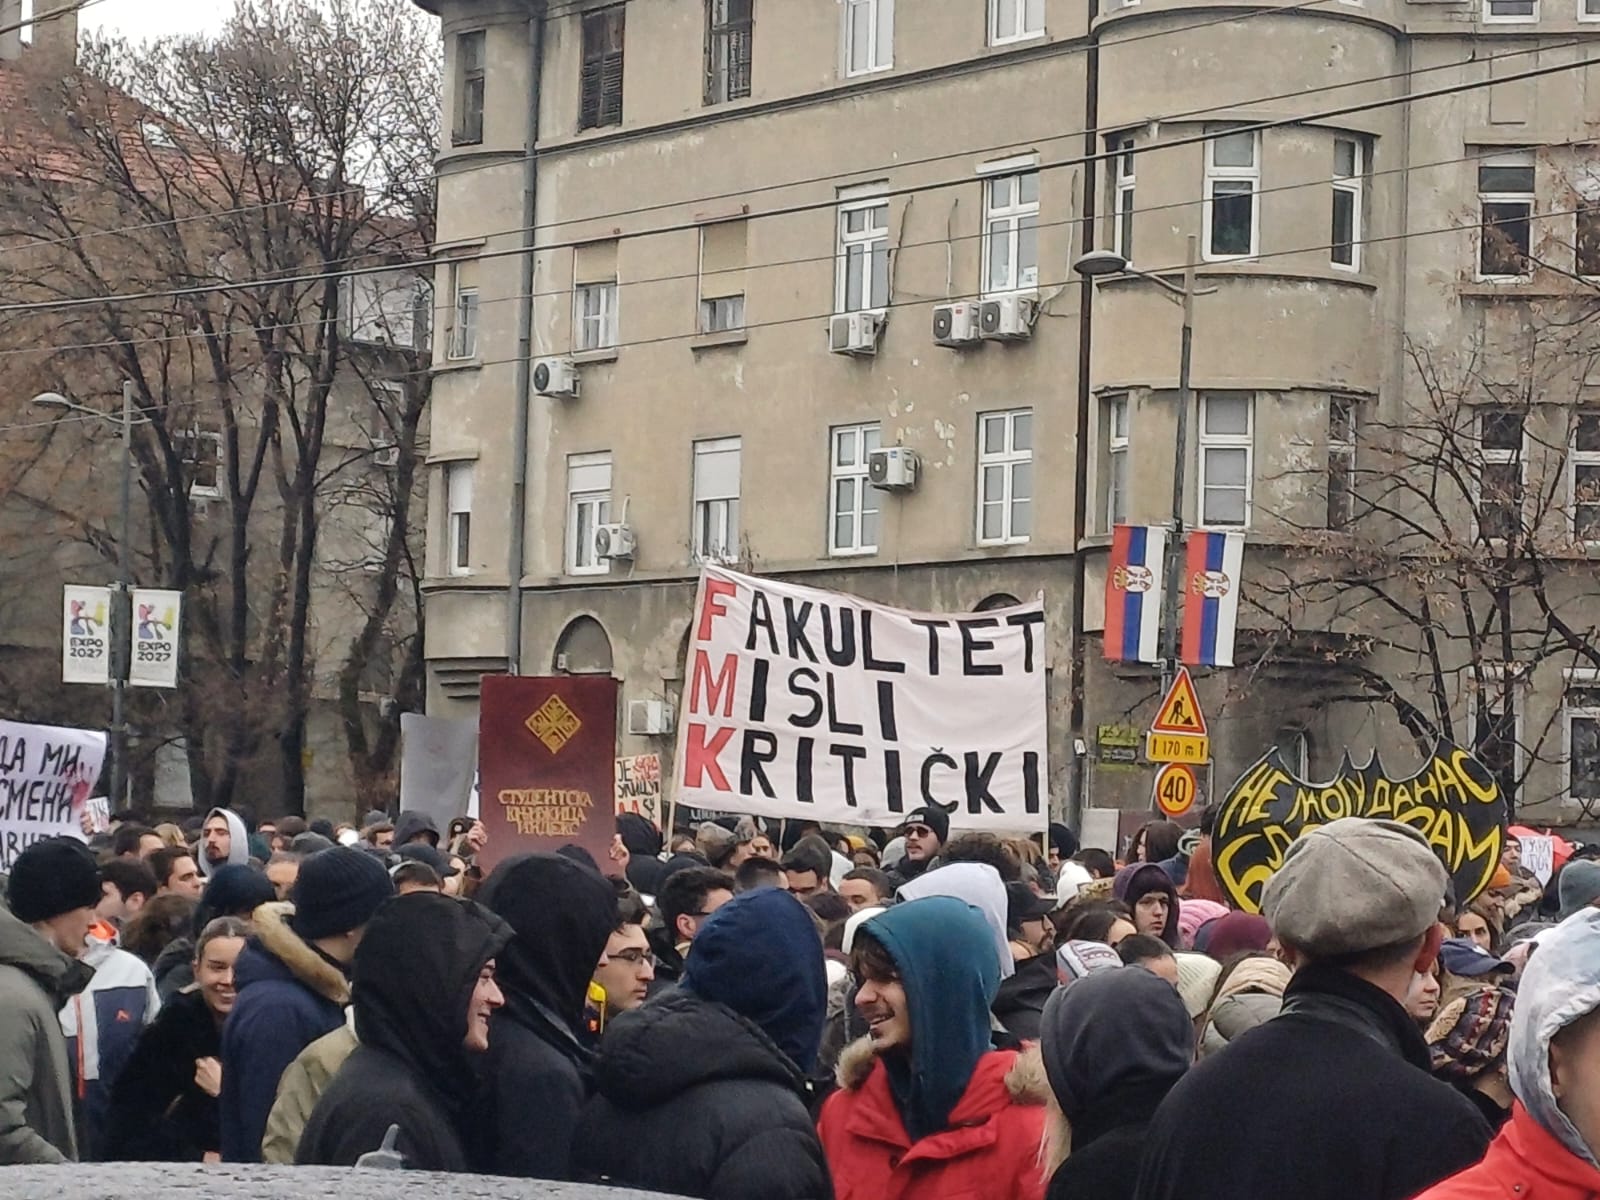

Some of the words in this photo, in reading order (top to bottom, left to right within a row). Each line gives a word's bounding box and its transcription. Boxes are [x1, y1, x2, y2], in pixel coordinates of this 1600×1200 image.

[696, 577, 1045, 676] FAKULTET
[70, 638, 104, 648] EXPO
[70, 648, 104, 658] 2027
[137, 641, 172, 652] EXPO
[137, 651, 172, 662] 2027
[689, 649, 899, 742] MISLI
[1163, 740, 1181, 756] 170
[683, 723, 1040, 815] KRITIČKI
[1163, 776, 1187, 804] 40
[1219, 762, 1292, 839] НЕ
[1365, 749, 1498, 817] ДАНАС
